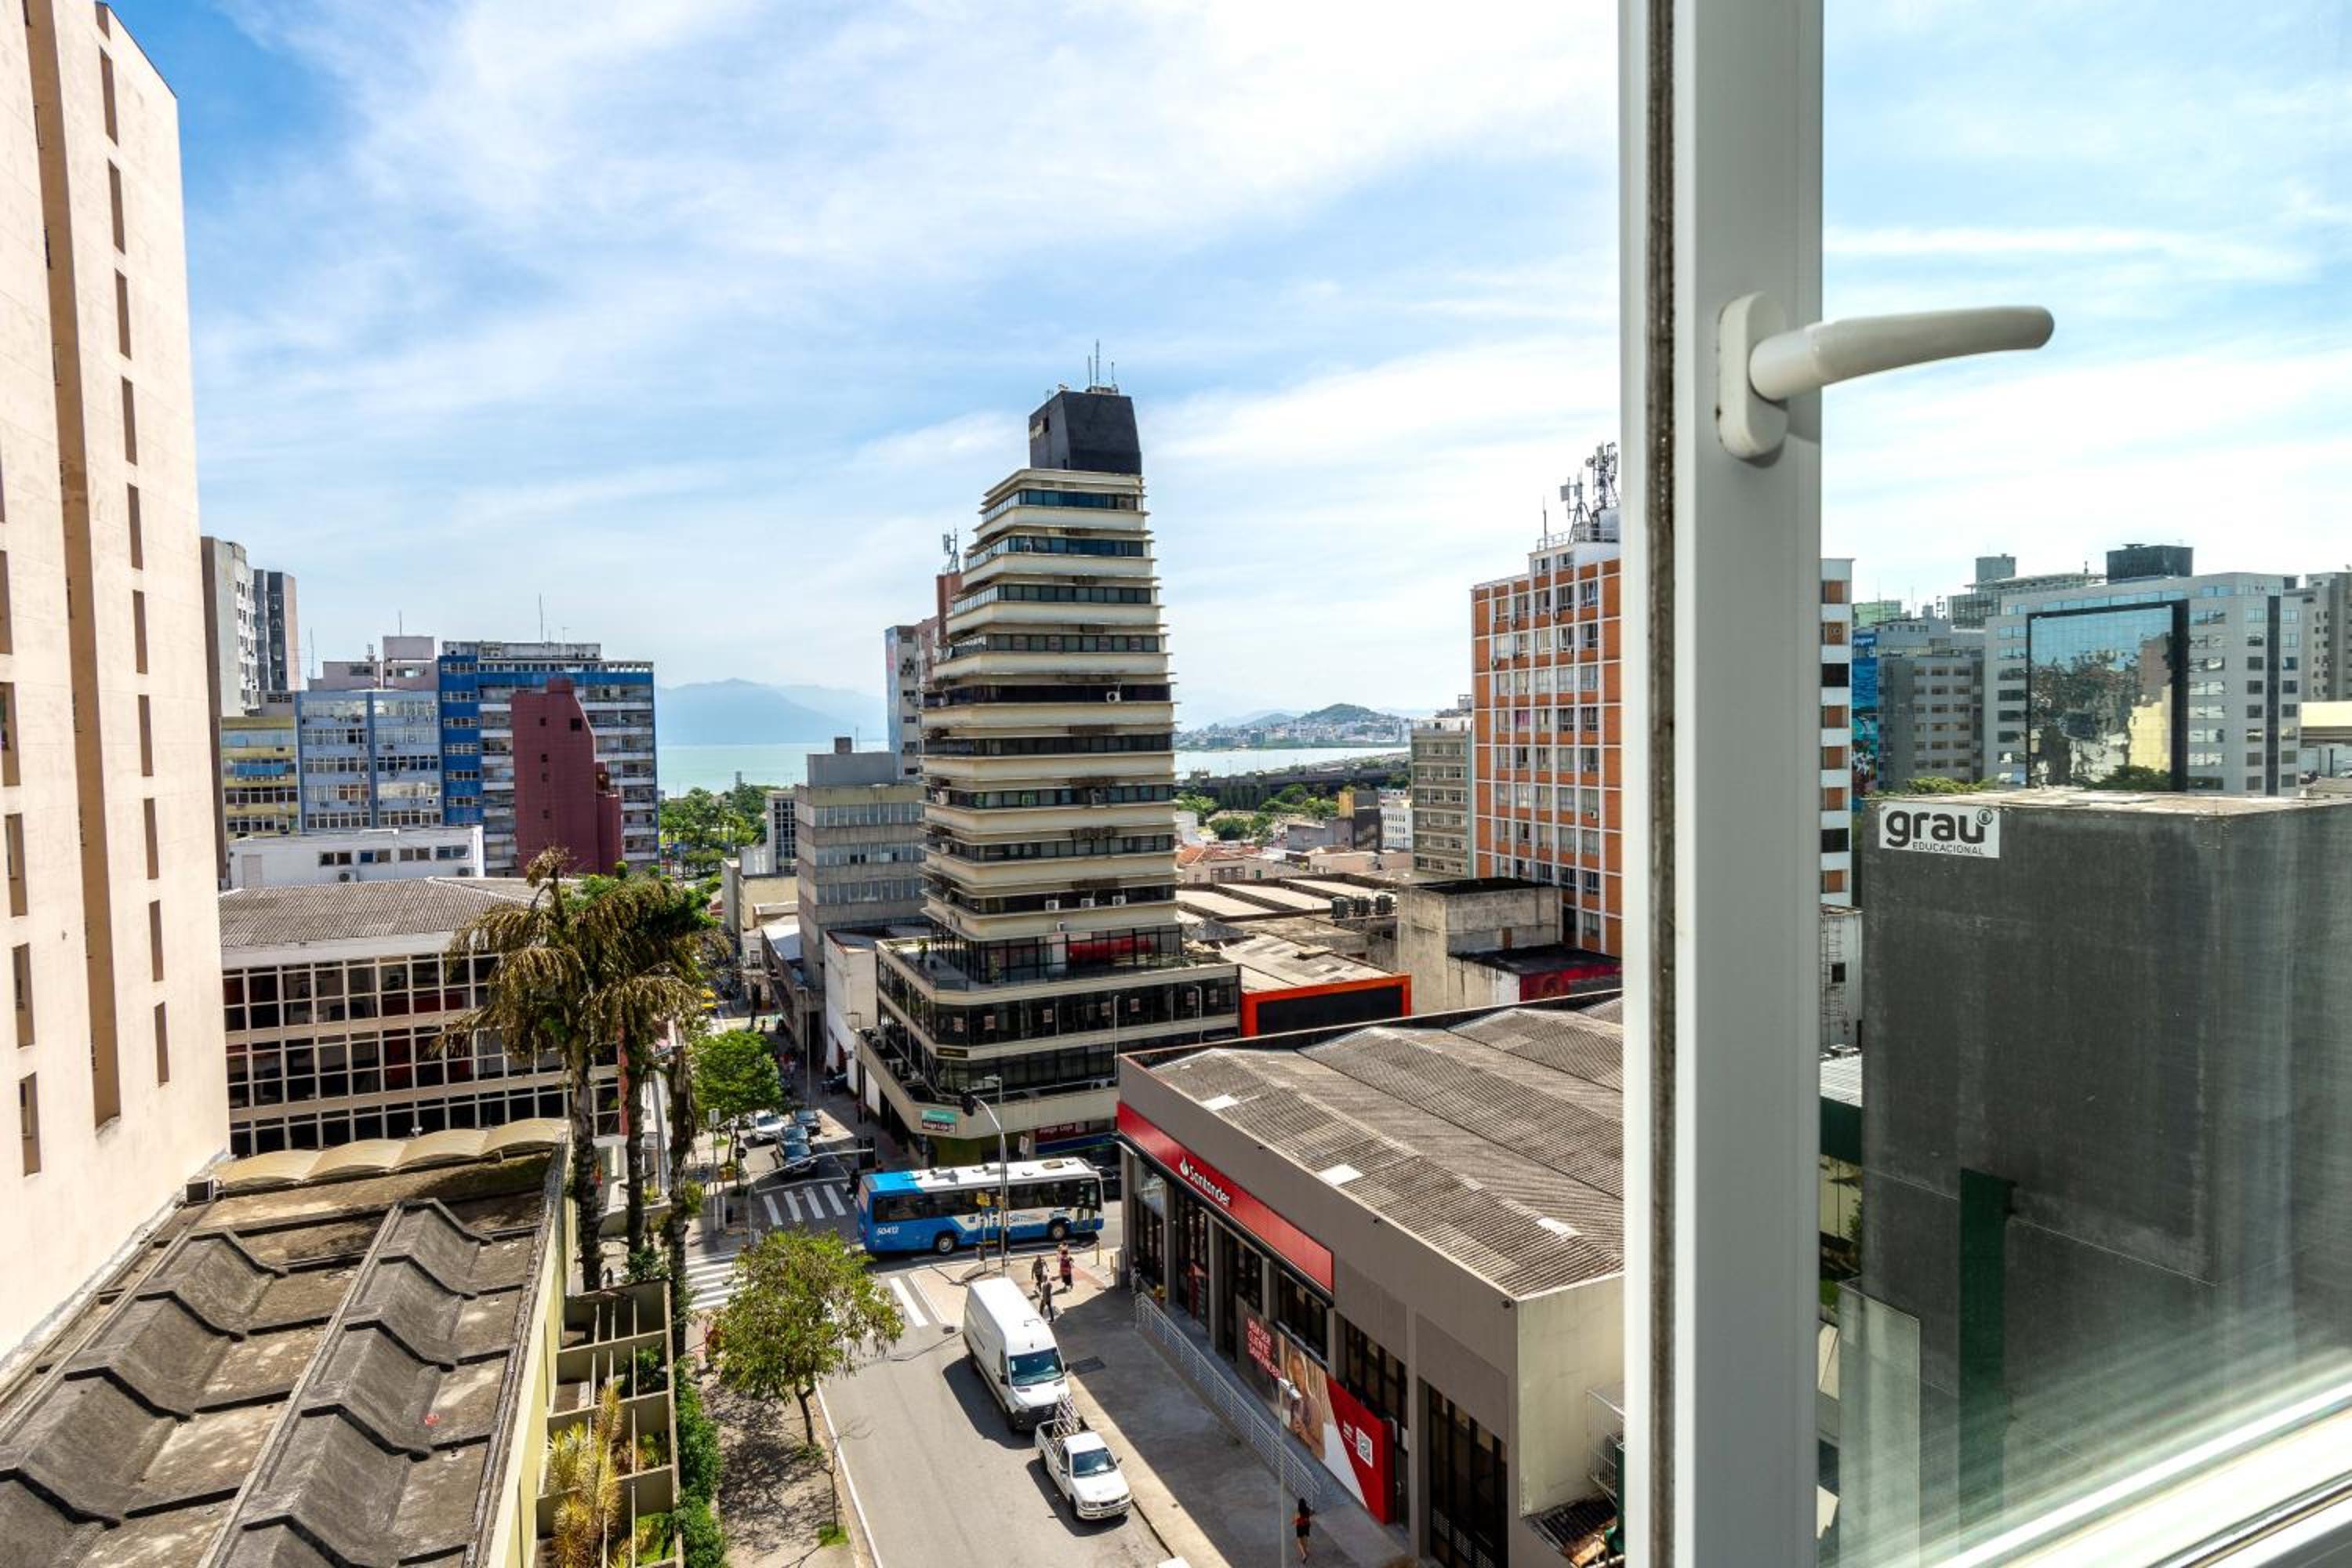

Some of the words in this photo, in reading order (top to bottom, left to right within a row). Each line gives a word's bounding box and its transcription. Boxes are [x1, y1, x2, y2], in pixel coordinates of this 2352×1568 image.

[1886, 811, 1984, 848] grau
[1913, 841, 1984, 855] EDUCACIONAL
[1189, 1164, 1230, 1206] Santander
